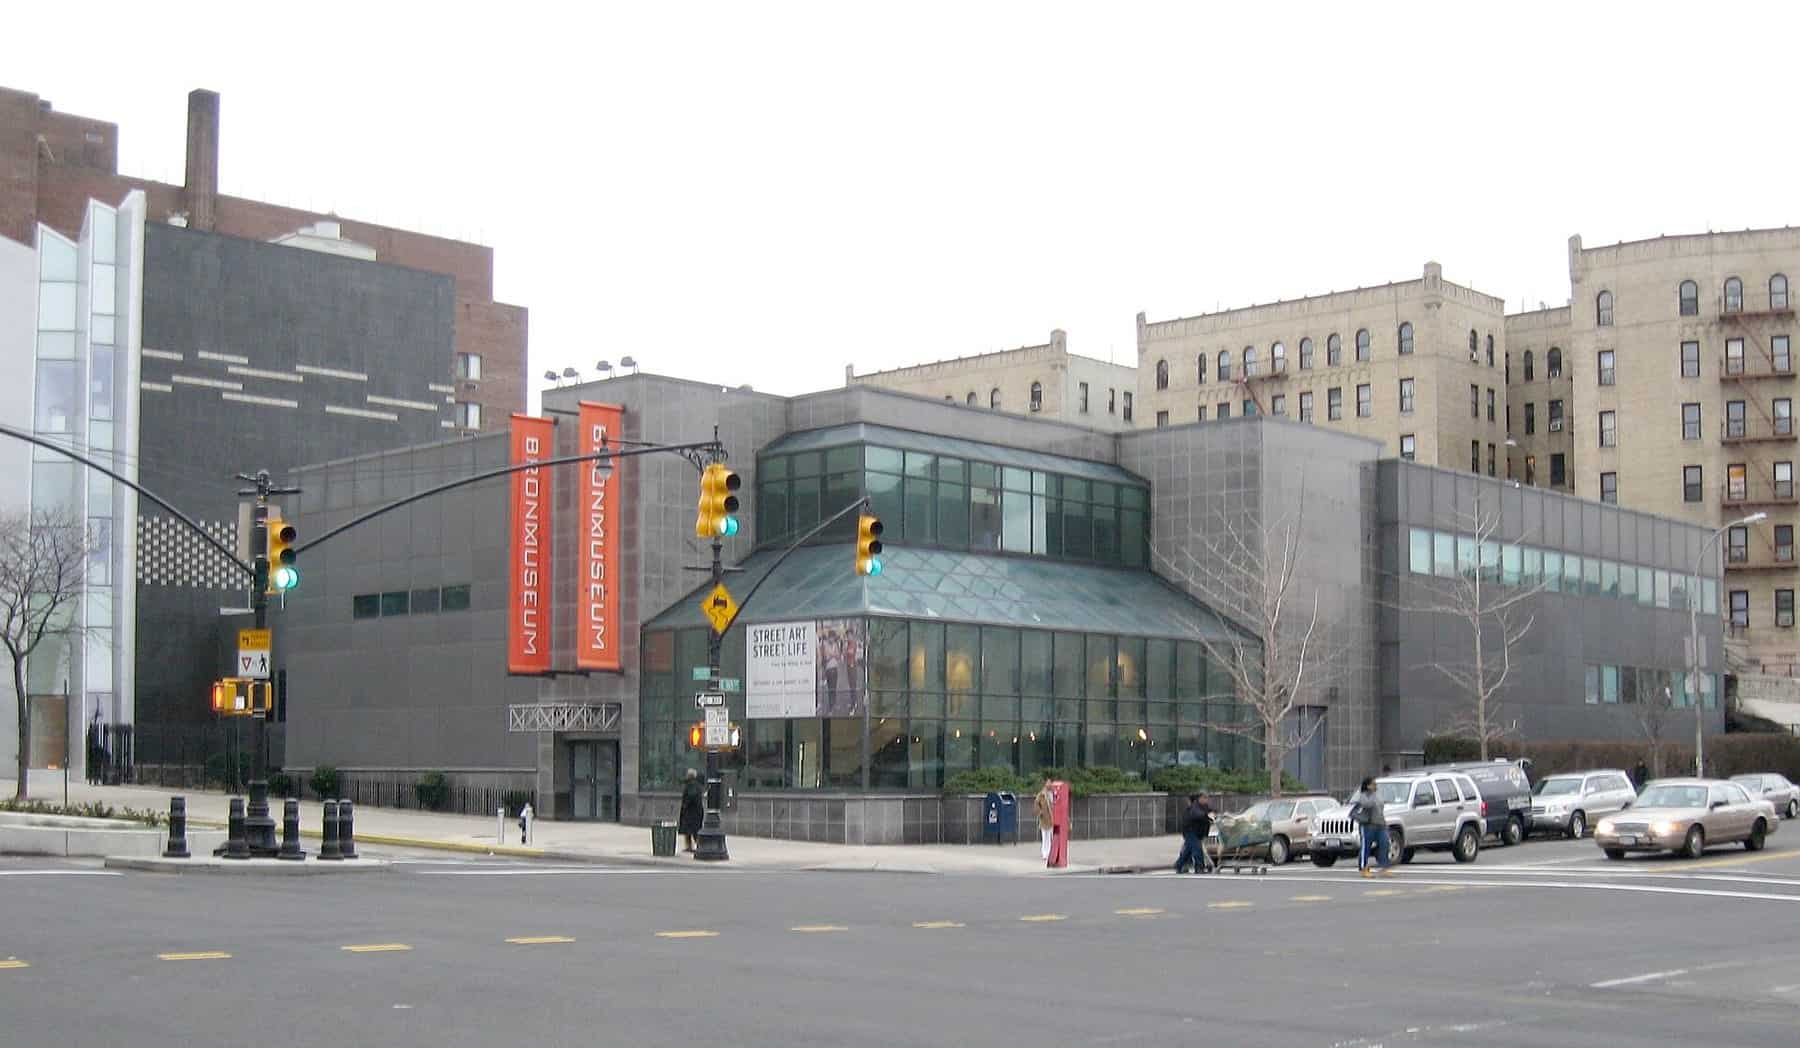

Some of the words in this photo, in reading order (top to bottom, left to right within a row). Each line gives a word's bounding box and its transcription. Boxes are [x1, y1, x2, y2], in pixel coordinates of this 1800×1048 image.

[753, 628, 785, 643] STREET
[789, 627, 807, 640] ART
[753, 643, 785, 658] STREET
[787, 642, 807, 656] LIFE
